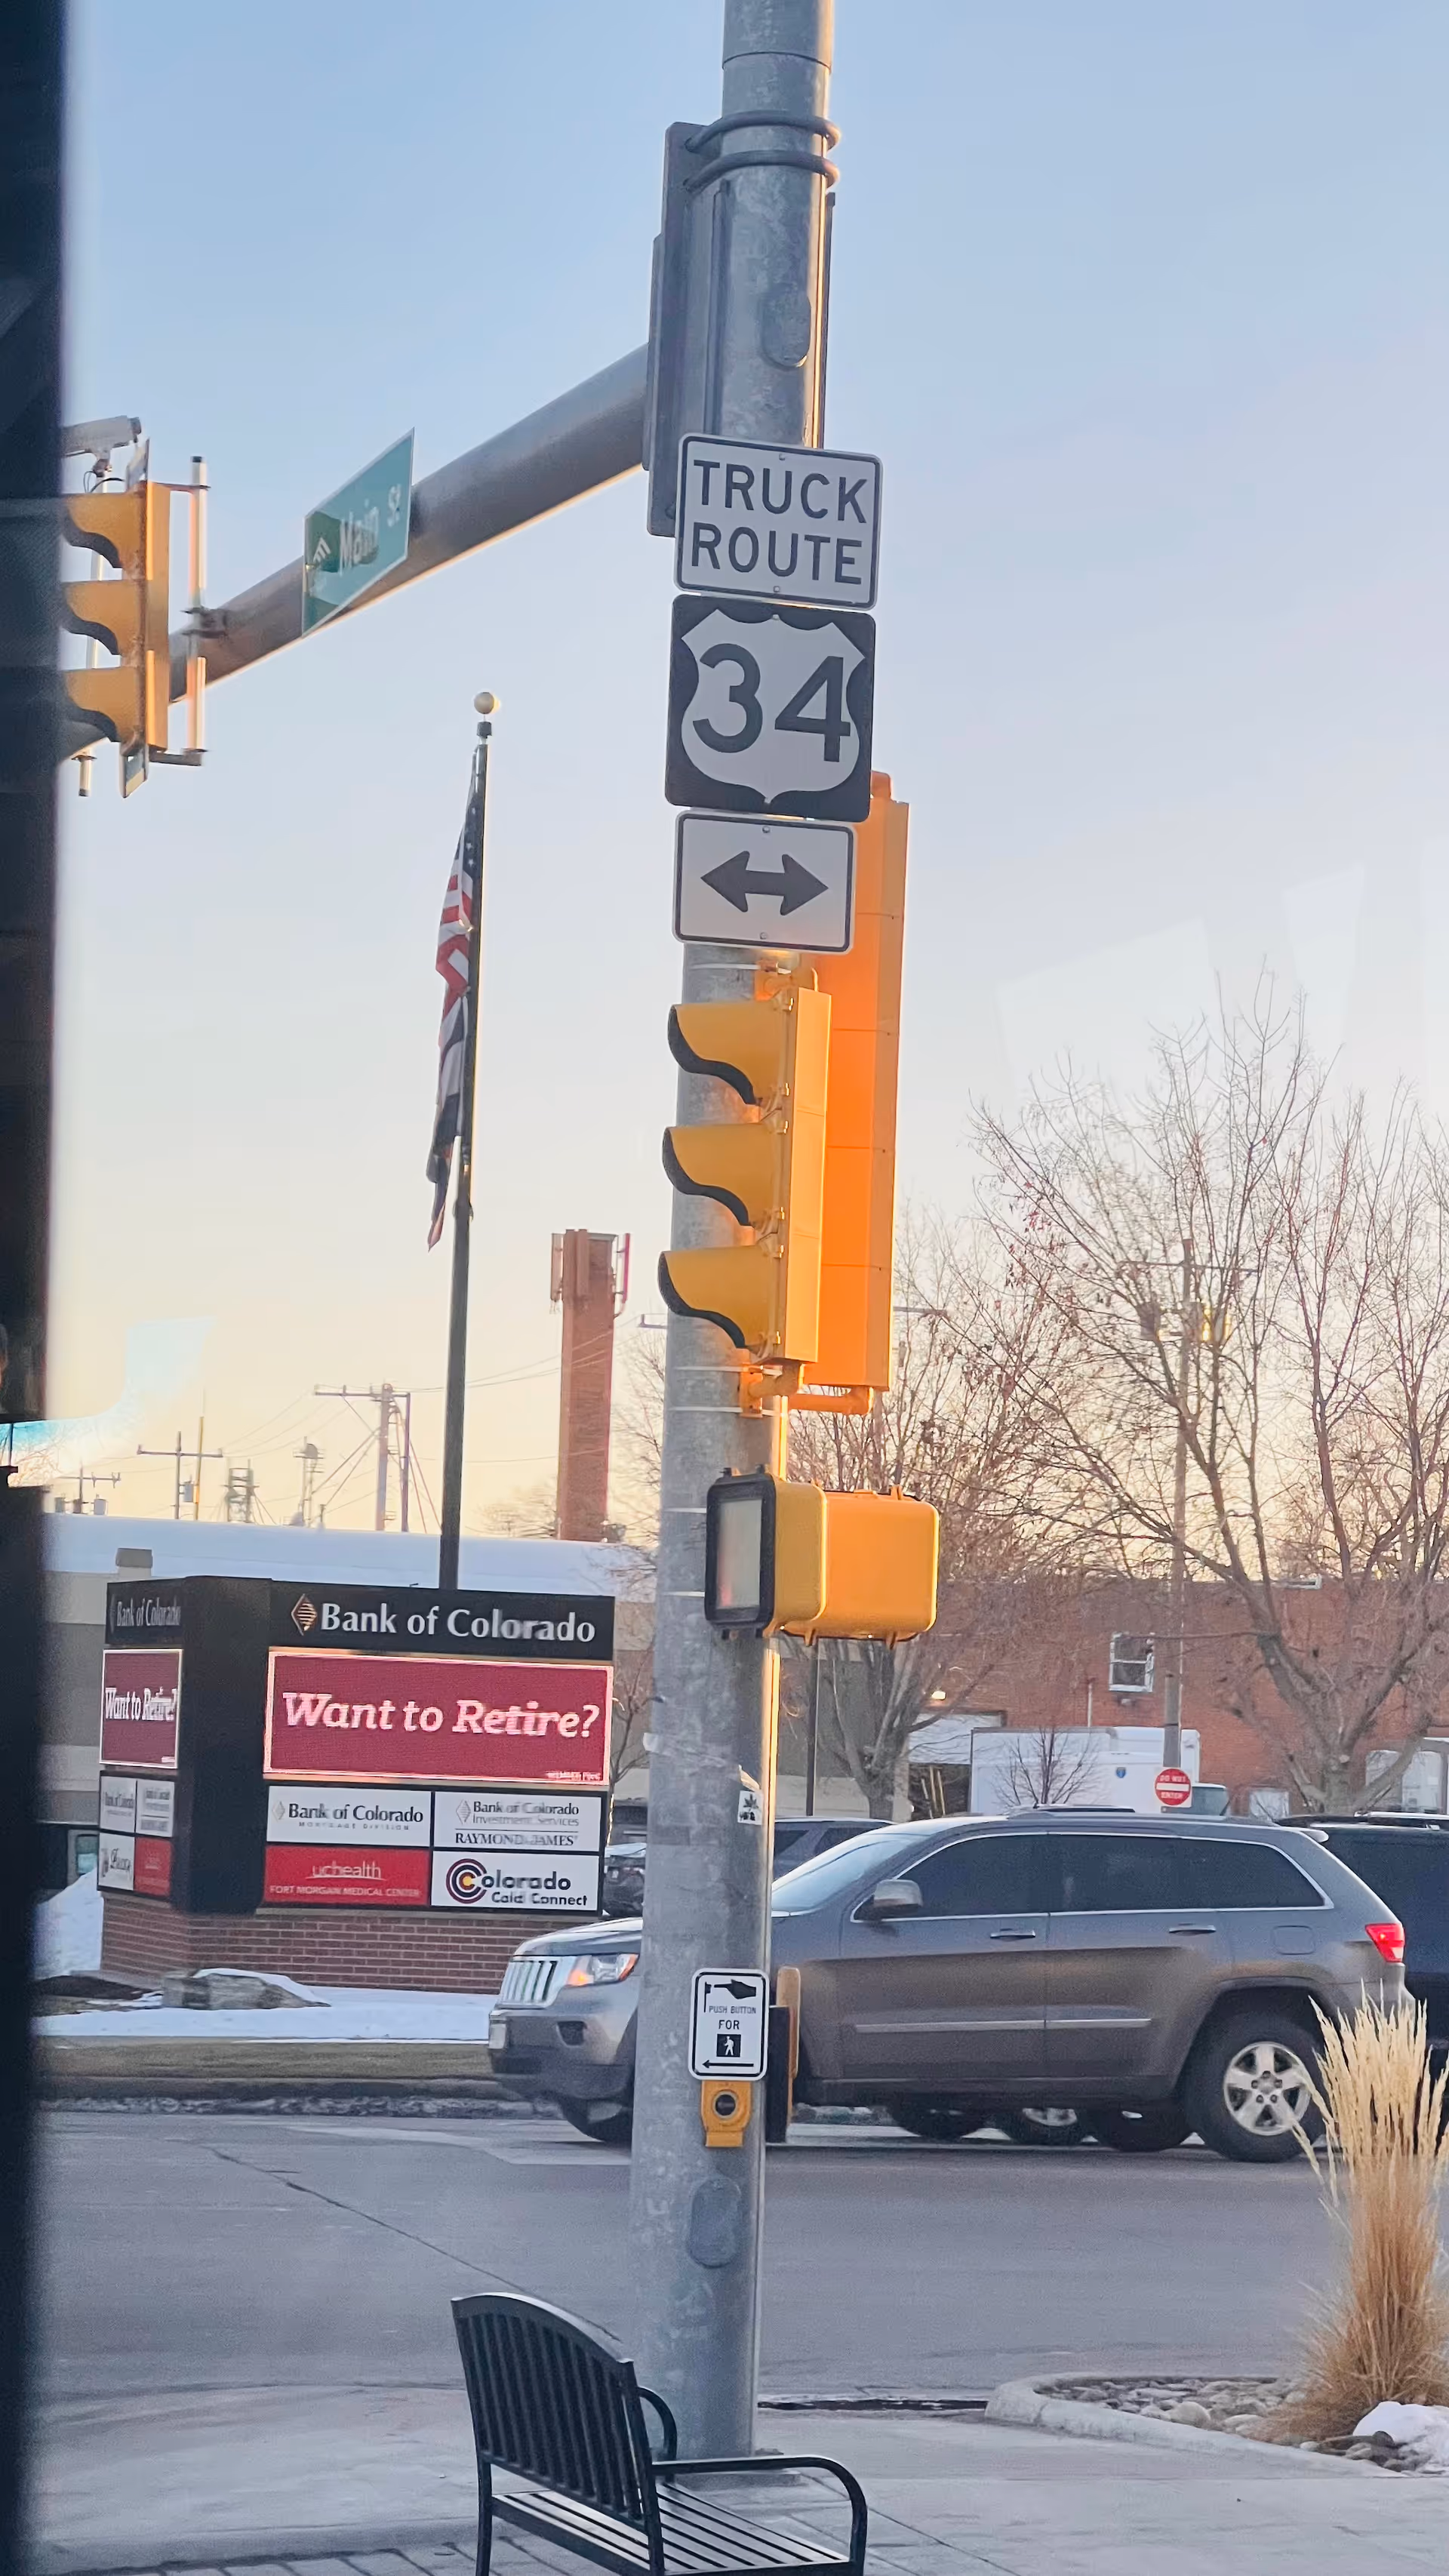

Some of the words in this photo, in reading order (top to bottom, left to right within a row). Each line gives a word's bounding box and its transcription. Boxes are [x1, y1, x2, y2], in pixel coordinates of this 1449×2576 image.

[693, 459, 868, 524] TRUCK
[340, 497, 380, 574] Main
[691, 522, 863, 586] ROUTE
[693, 642, 851, 763] 34
[116, 1597, 134, 1627] Bank
[136, 1597, 146, 1627] of
[320, 1602, 398, 1634] Bank
[407, 1605, 440, 1636] of
[446, 1608, 596, 1643] Colorado
[105, 1687, 131, 1719] Want
[131, 1691, 141, 1721] to
[282, 1691, 397, 1731] Want
[401, 1700, 445, 1732] to
[452, 1698, 601, 1738] Retire?
[288, 1802, 328, 1819] Bank
[333, 1805, 350, 1820] of
[352, 1805, 424, 1823] Colorado
[472, 1800, 503, 1814] Bank
[506, 1802, 520, 1814] of
[521, 1802, 580, 1816] Colorado
[472, 1813, 533, 1826] Investment
[537, 1814, 580, 1827] Services
[455, 1832, 525, 1846] RAYMOND
[312, 1859, 382, 1879] uchealth
[269, 1885, 294, 1894] FORT
[343, 1887, 384, 1897] MEDICAL
[531, 1892, 589, 1907] Connect
[731, 2005, 756, 2014] BUTTON
[718, 2019, 740, 2030] FOR
